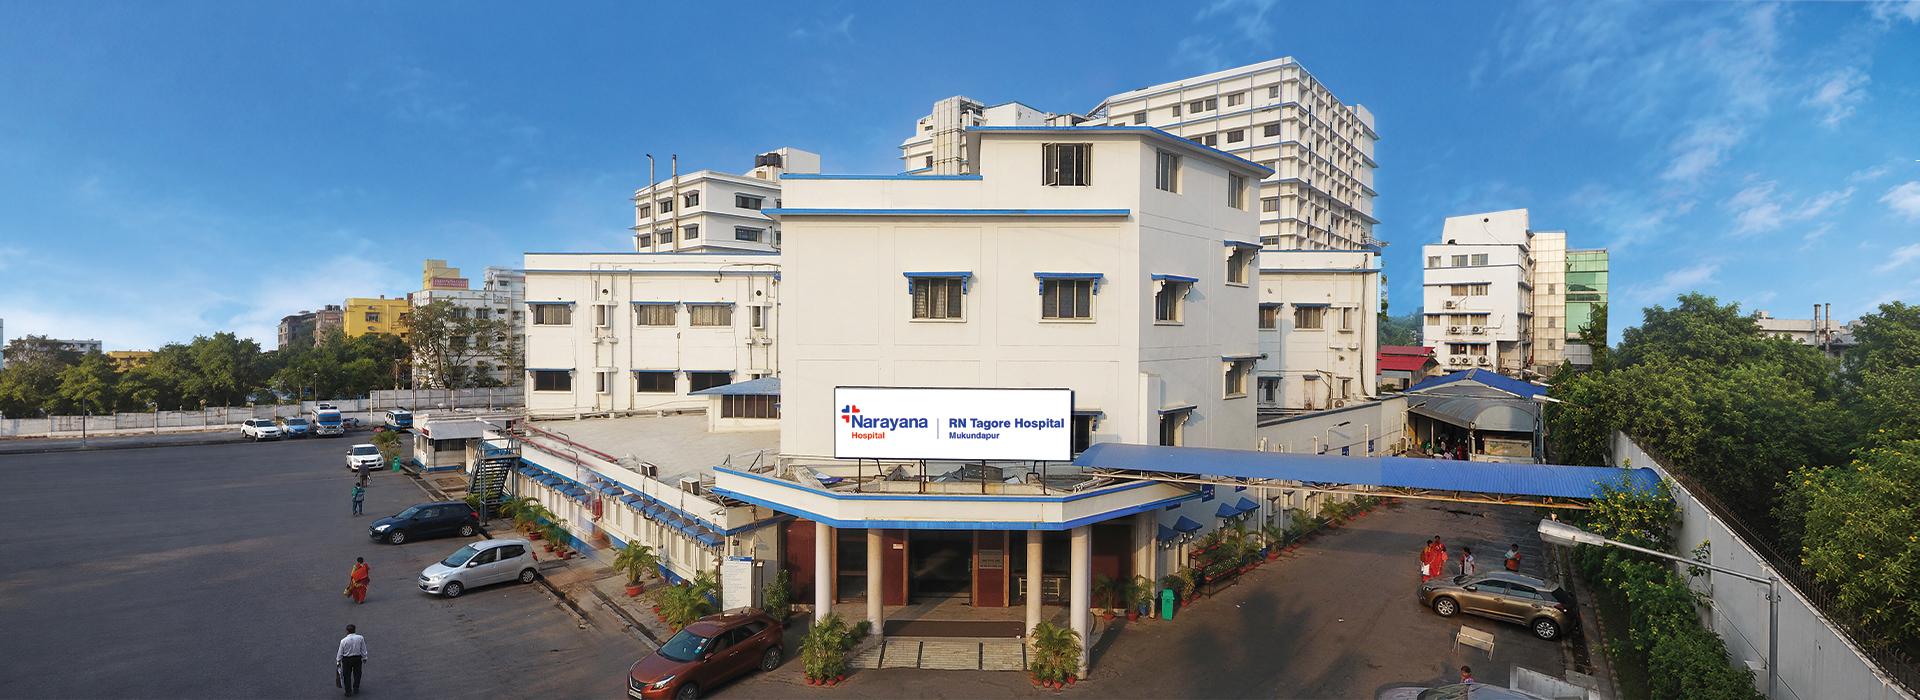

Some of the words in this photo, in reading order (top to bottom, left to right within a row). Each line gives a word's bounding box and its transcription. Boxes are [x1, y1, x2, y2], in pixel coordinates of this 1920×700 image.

[851, 414, 928, 431] Narayana
[949, 418, 967, 429] RN
[970, 418, 1011, 431] Tagore
[1014, 417, 1065, 431] Hospital
[851, 431, 886, 441] Hospital
[949, 431, 1000, 441] Mukundapur
